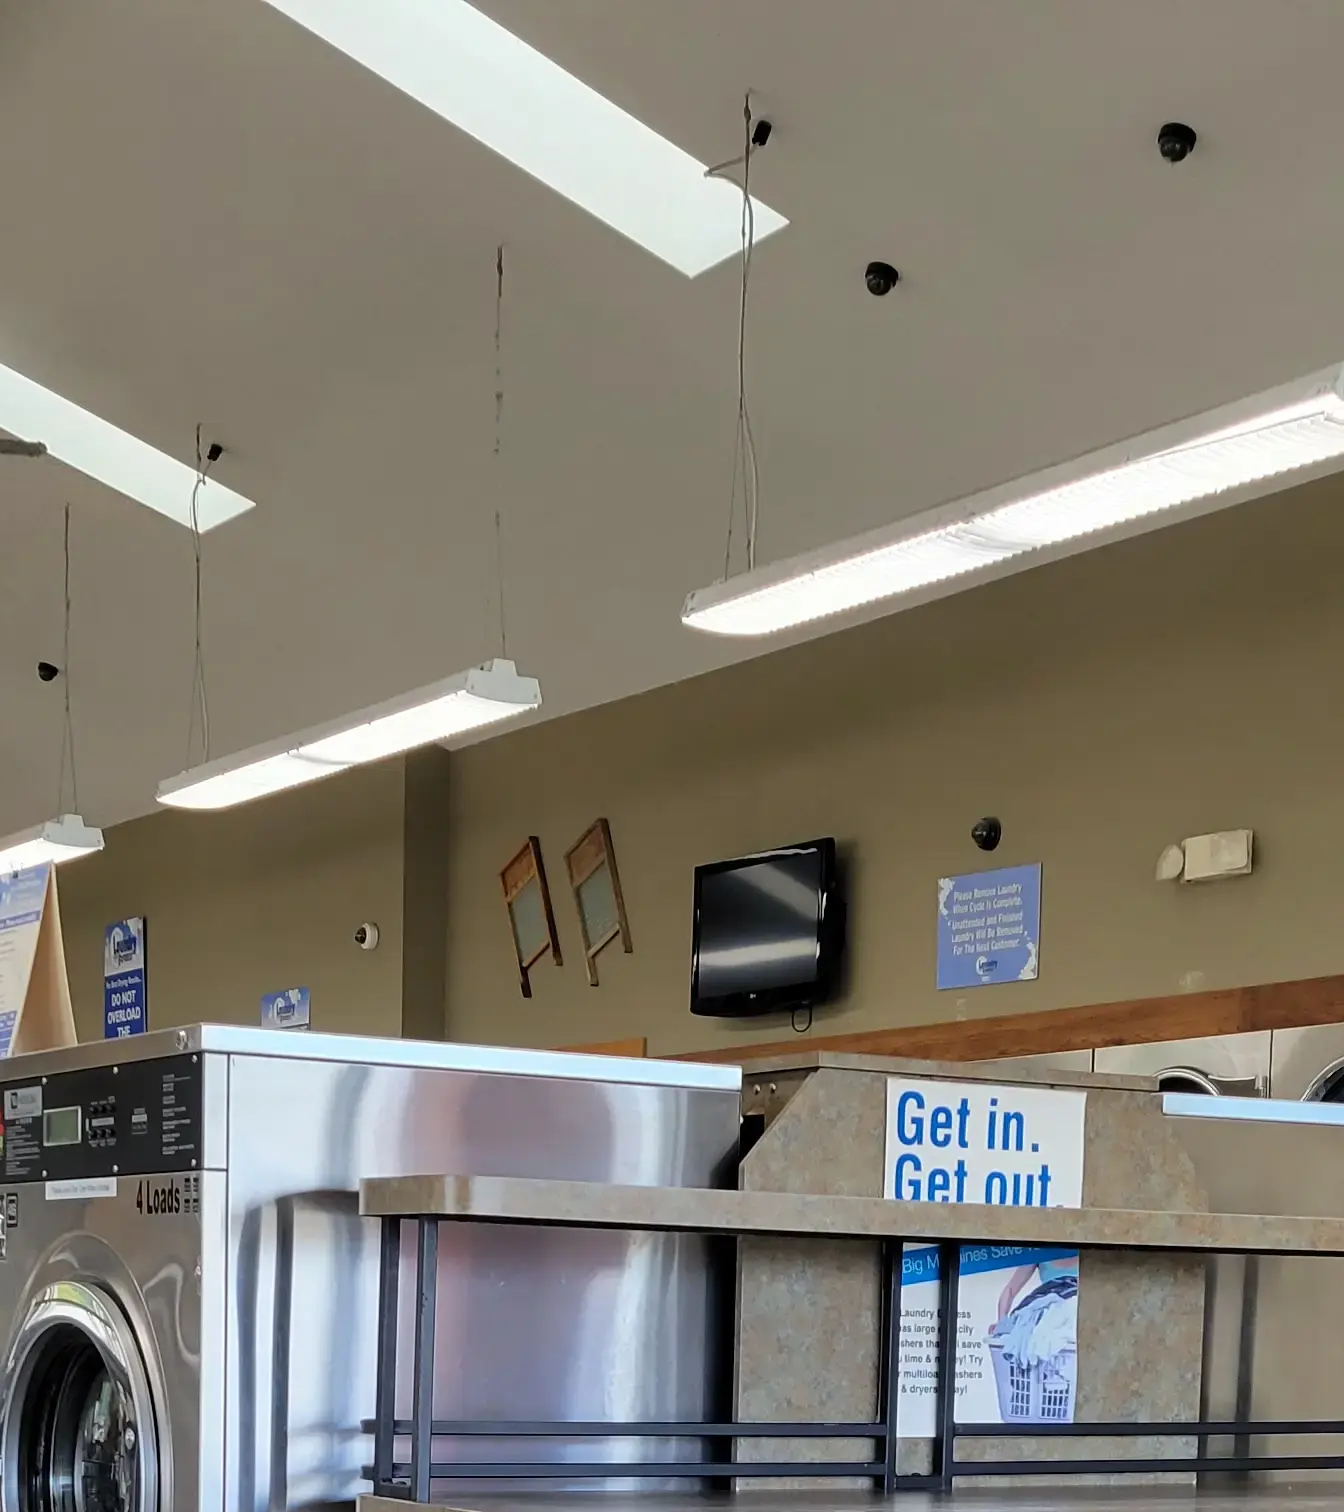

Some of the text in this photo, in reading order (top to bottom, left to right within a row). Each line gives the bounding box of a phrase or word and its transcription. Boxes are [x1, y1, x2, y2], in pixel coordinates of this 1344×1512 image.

[954, 883, 1022, 902] Please Remove Laundry
[953, 904, 968, 914] When
[969, 902, 985, 912] Cycle
[952, 917, 985, 930] Unattended
[999, 910, 1023, 923] Finished
[952, 931, 974, 942] Laundry
[987, 928, 995, 938] Be
[997, 924, 1023, 936] Removed
[953, 945, 963, 956] For
[964, 943, 975, 954] The
[111, 990, 136, 1007] DO NOT
[107, 1006, 142, 1024] OVERLOAD
[117, 1025, 131, 1038] THE
[896, 1090, 1040, 1153] Get in.
[894, 1153, 968, 1203] Get
[136, 1179, 143, 1215] 4
[146, 1177, 181, 1215] Loads
[902, 1258, 923, 1274] Big
[914, 1324, 936, 1335] large
[961, 1341, 982, 1349] save
[904, 1354, 923, 1363] time
[925, 1354, 932, 1363] &
[968, 1354, 984, 1366] Try
[903, 1369, 939, 1379] multiloa
[901, 1384, 907, 1394] &
[909, 1384, 938, 1396] dryers
